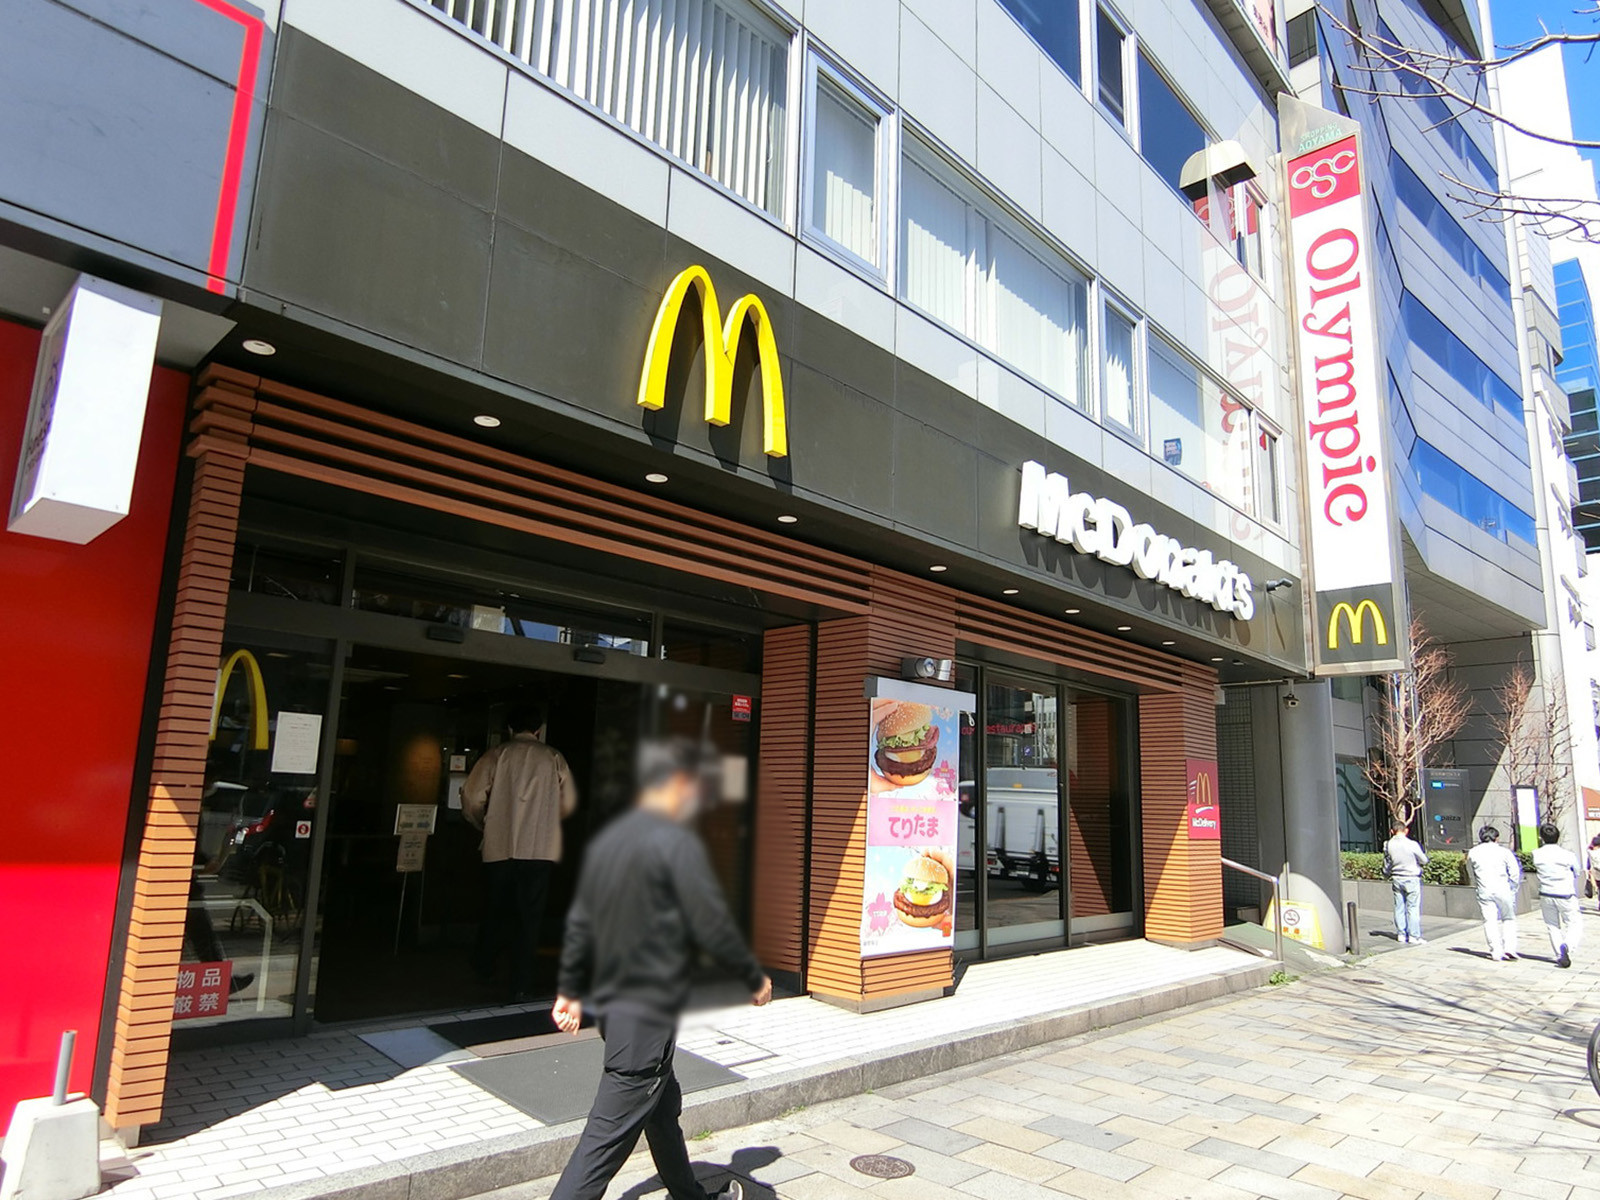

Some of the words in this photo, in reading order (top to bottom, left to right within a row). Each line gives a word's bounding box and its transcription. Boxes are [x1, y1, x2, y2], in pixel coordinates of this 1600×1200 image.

[1298, 129, 1343, 152] AOYAMA
[1302, 228, 1376, 527] Olympic
[1018, 460, 1256, 621] McDonald's
[888, 814, 939, 839] てりたま
[178, 968, 221, 989] 物品
